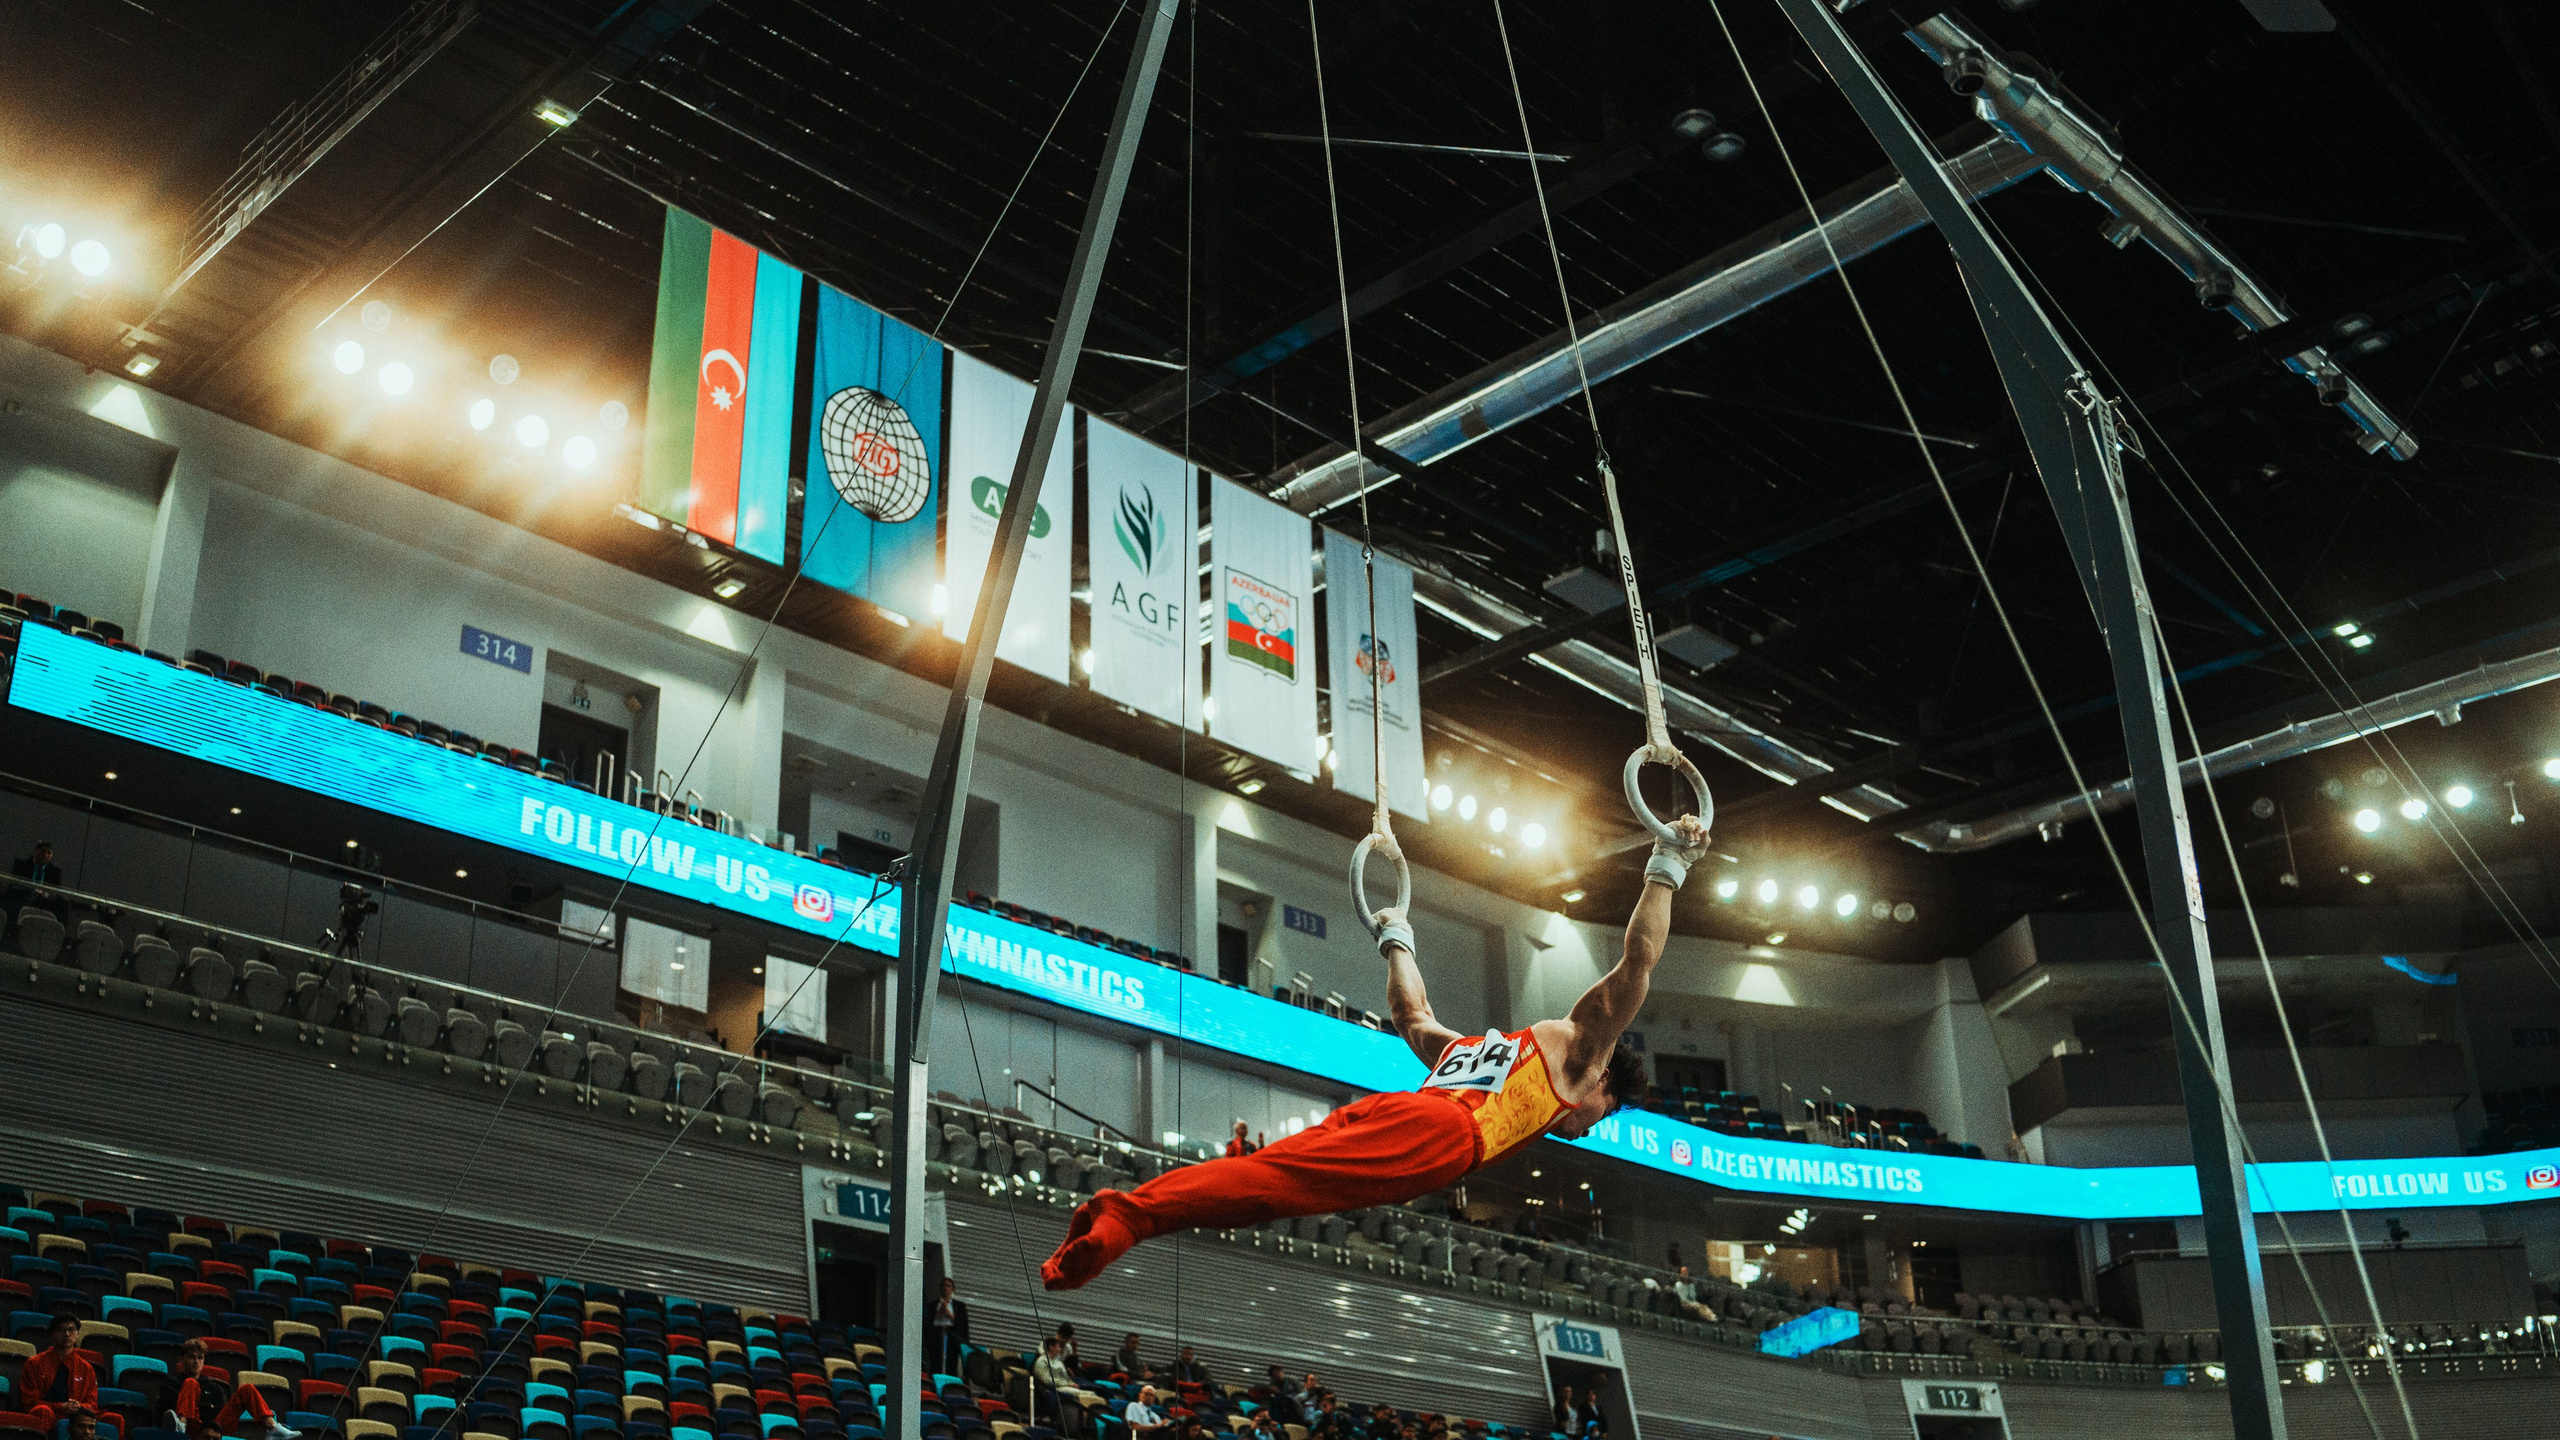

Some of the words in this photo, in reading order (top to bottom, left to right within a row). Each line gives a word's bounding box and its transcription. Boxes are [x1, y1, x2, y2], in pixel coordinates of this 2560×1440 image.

[1111, 581, 1179, 631] AGF
[1621, 555, 1650, 660] SPIETH
[477, 634, 516, 664] 314
[520, 796, 696, 881] FOLLOW
[715, 855, 771, 902] US
[852, 896, 1145, 1010] AZYMNASTICS
[1292, 910, 1318, 933] 313
[1437, 1043, 1513, 1077] 614
[1630, 1124, 1659, 1155] US
[1702, 1146, 1924, 1193] AZEGYMNASTICS
[2332, 1172, 2449, 1199] FOLLOW
[2464, 1169, 2507, 1193] US
[1566, 1330, 1594, 1352] 113
[1938, 1389, 1969, 1408] 112
